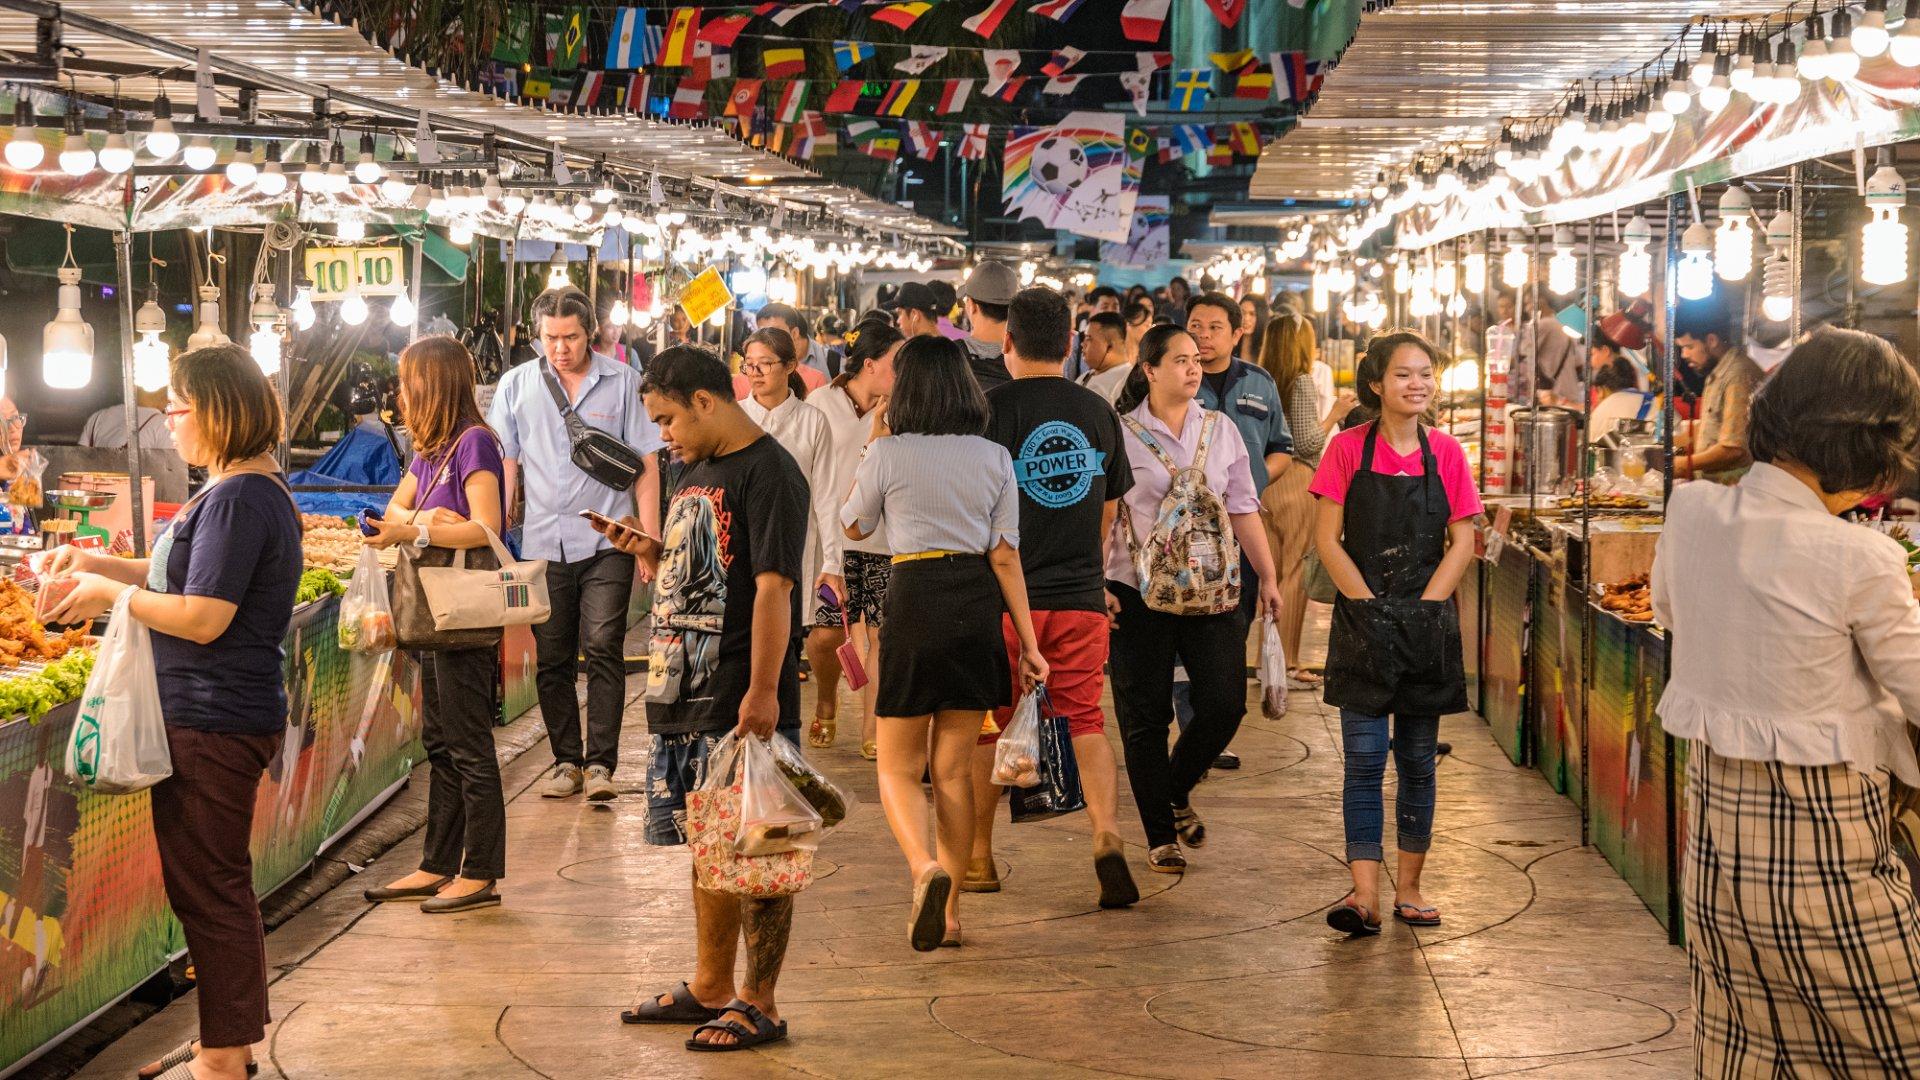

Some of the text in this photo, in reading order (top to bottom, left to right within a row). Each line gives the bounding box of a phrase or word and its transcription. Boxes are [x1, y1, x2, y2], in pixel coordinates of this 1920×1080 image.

[314, 260, 348, 293] 10
[364, 256, 393, 285] 10
[1025, 441, 1036, 457] 100
[1042, 428, 1058, 437] Good
[1025, 453, 1087, 477] POWER
[1055, 490, 1073, 501] Good
